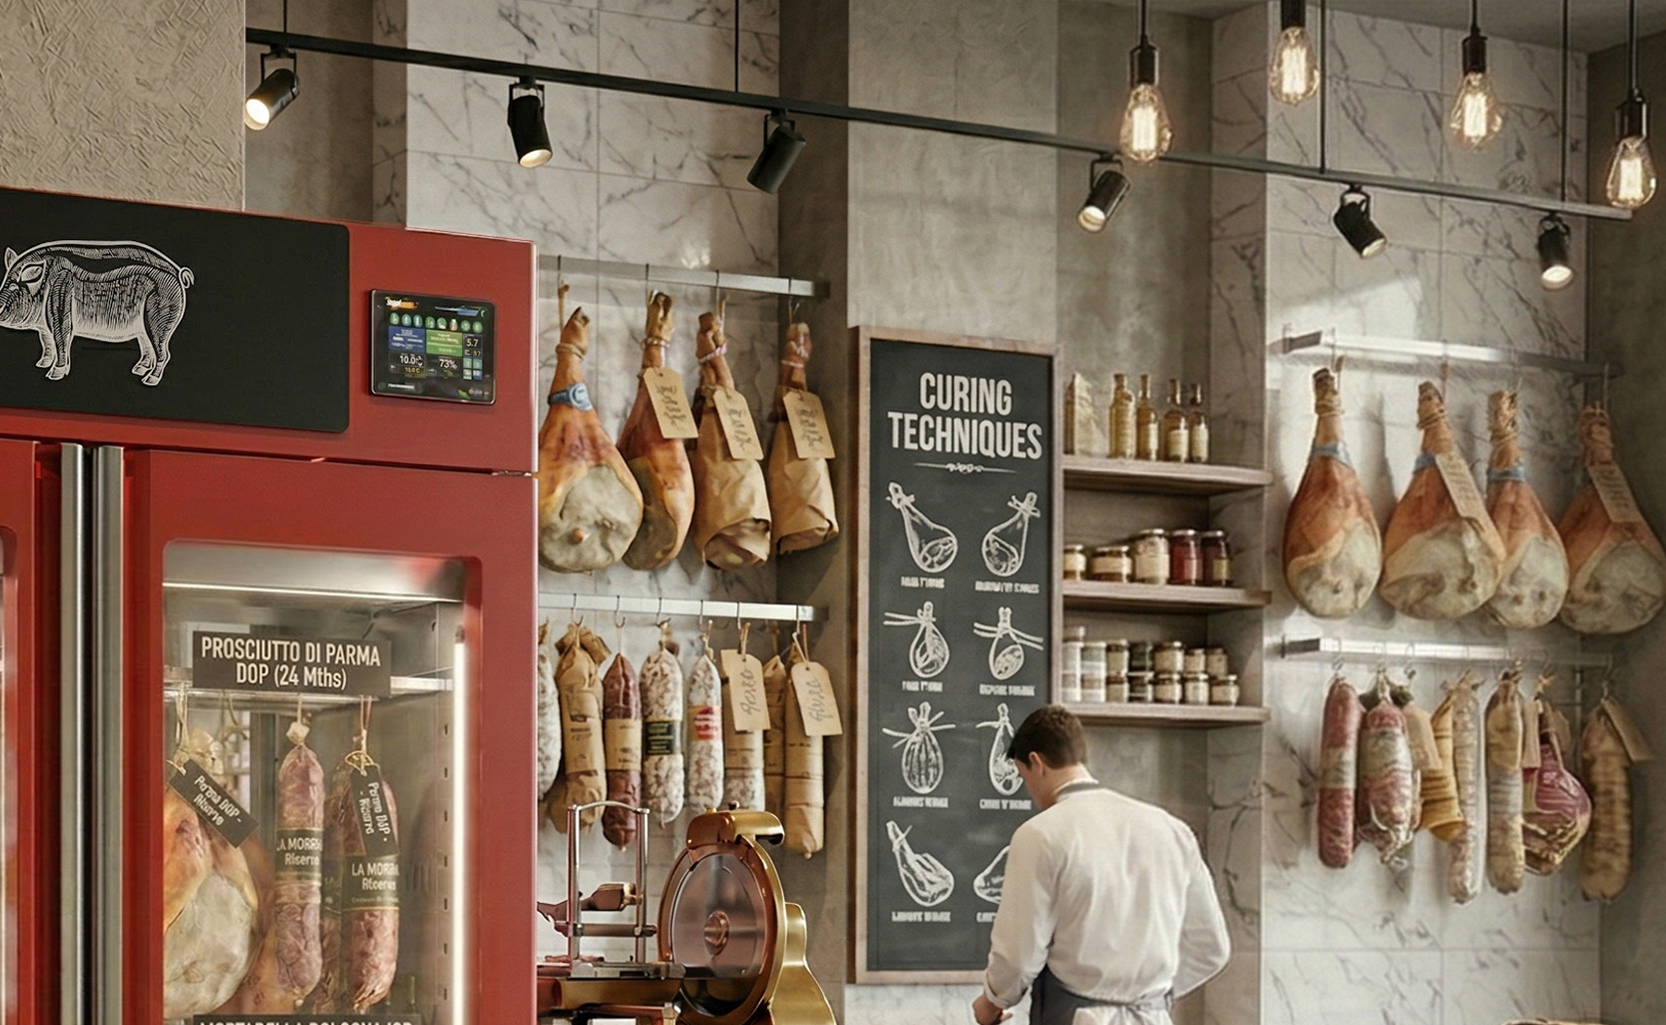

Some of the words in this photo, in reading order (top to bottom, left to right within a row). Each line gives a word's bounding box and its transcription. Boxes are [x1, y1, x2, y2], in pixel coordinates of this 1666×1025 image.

[920, 372, 1012, 416] CURING
[887, 411, 1043, 460] TECHNIQUES
[201, 636, 300, 663] PROSCIUTTO
[305, 642, 321, 662] DI
[326, 644, 381, 667] PARMA
[236, 662, 269, 685] DOP
[274, 665, 299, 688] (24
[303, 666, 347, 690] Mths)
[352, 863, 364, 876] LA
